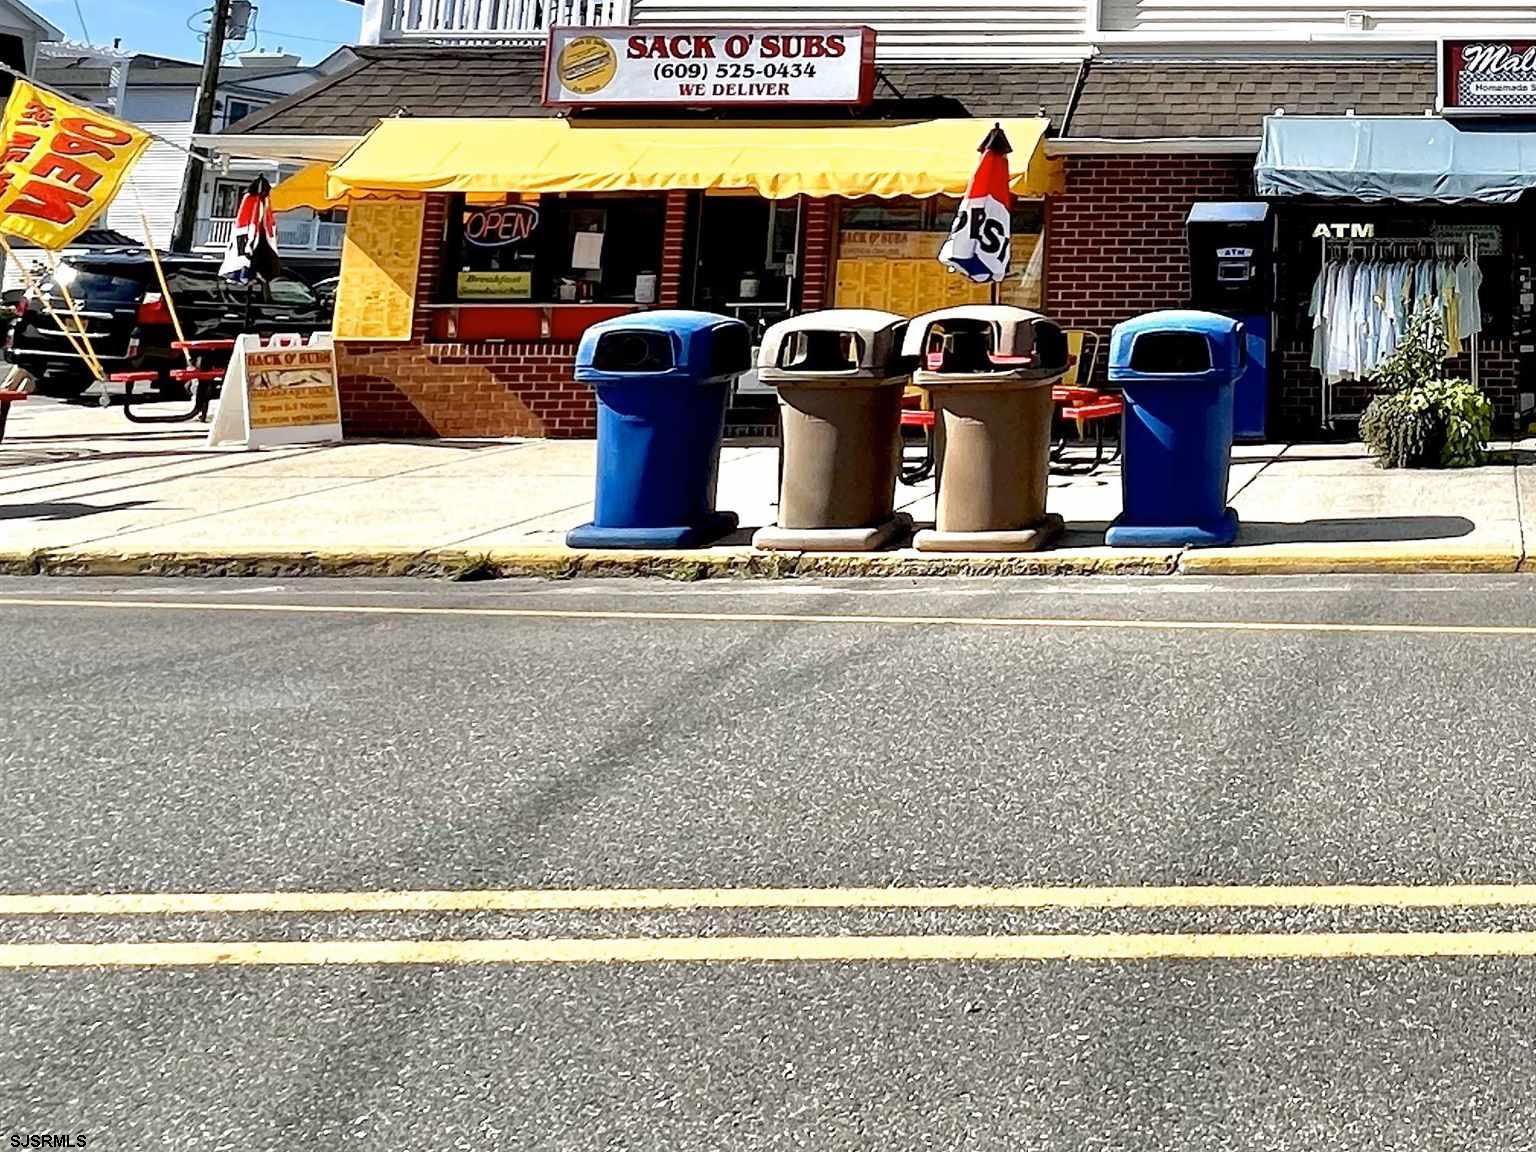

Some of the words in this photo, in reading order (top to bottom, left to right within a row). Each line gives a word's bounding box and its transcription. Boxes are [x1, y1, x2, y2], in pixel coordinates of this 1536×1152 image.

[626, 35, 717, 59] SACK
[724, 35, 753, 58] O'
[759, 35, 846, 59] SUBS
[653, 63, 707, 81] (609)
[715, 63, 817, 79] 525-0434
[679, 83, 706, 96] WE
[712, 83, 790, 96] DELIVER
[1475, 83, 1528, 91] Homemade
[467, 211, 533, 239] OPEN
[1312, 223, 1375, 238] ATM
